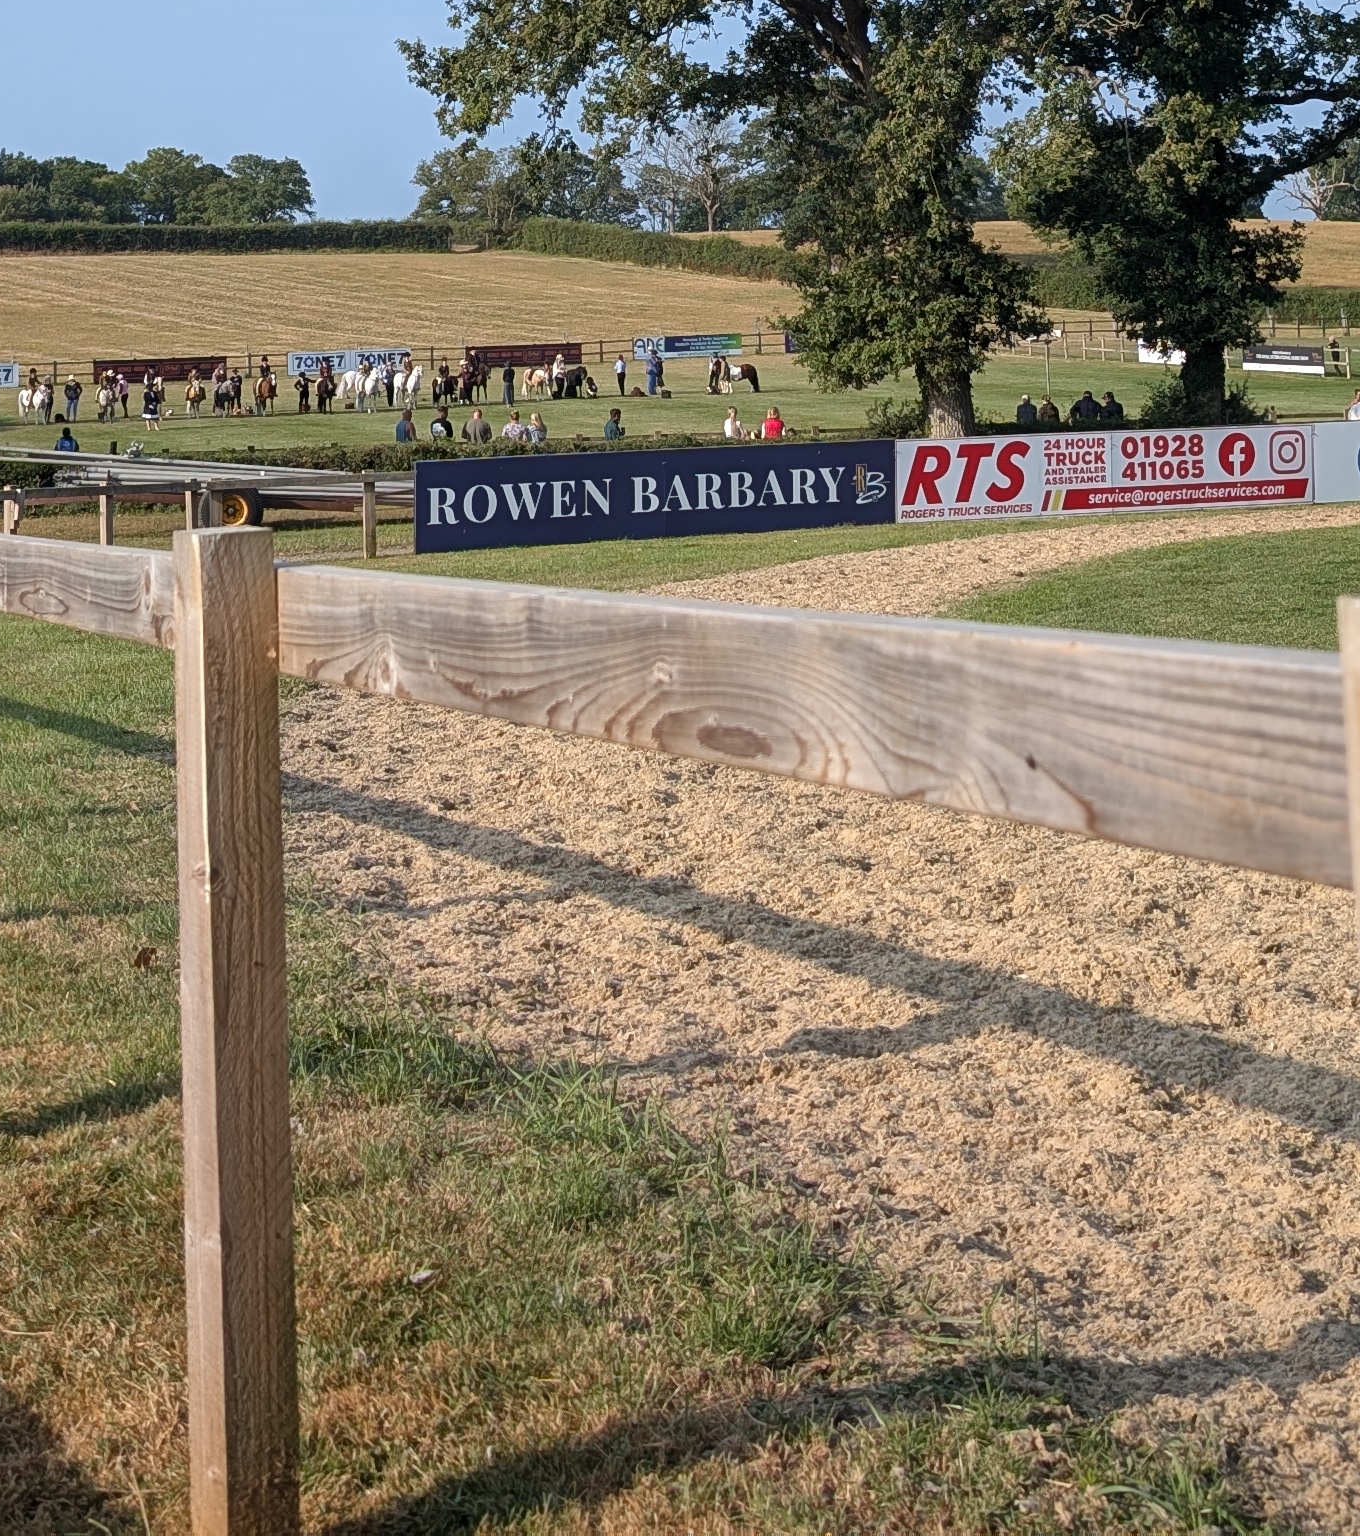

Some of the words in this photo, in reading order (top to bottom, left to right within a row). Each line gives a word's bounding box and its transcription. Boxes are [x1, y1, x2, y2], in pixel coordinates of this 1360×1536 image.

[1044, 438, 1062, 451] 24
[1065, 437, 1106, 450] HOUR
[1120, 433, 1205, 460] 01928
[1044, 450, 1106, 466] TRUCK
[901, 440, 1031, 505] RTS
[1044, 467, 1065, 477] AND
[1066, 465, 1107, 475] TRAILER
[1044, 474, 1107, 485] ASSISTANCE
[1121, 459, 1205, 482] 411065
[426, 478, 613, 525] ROWEN
[631, 466, 846, 514] BARBARY
[1088, 483, 1285, 505] service@rogerstruckservices.com
[900, 507, 945, 520] ROGER'S
[948, 505, 981, 518] TRUCK
[983, 503, 1033, 515] SERVICES
